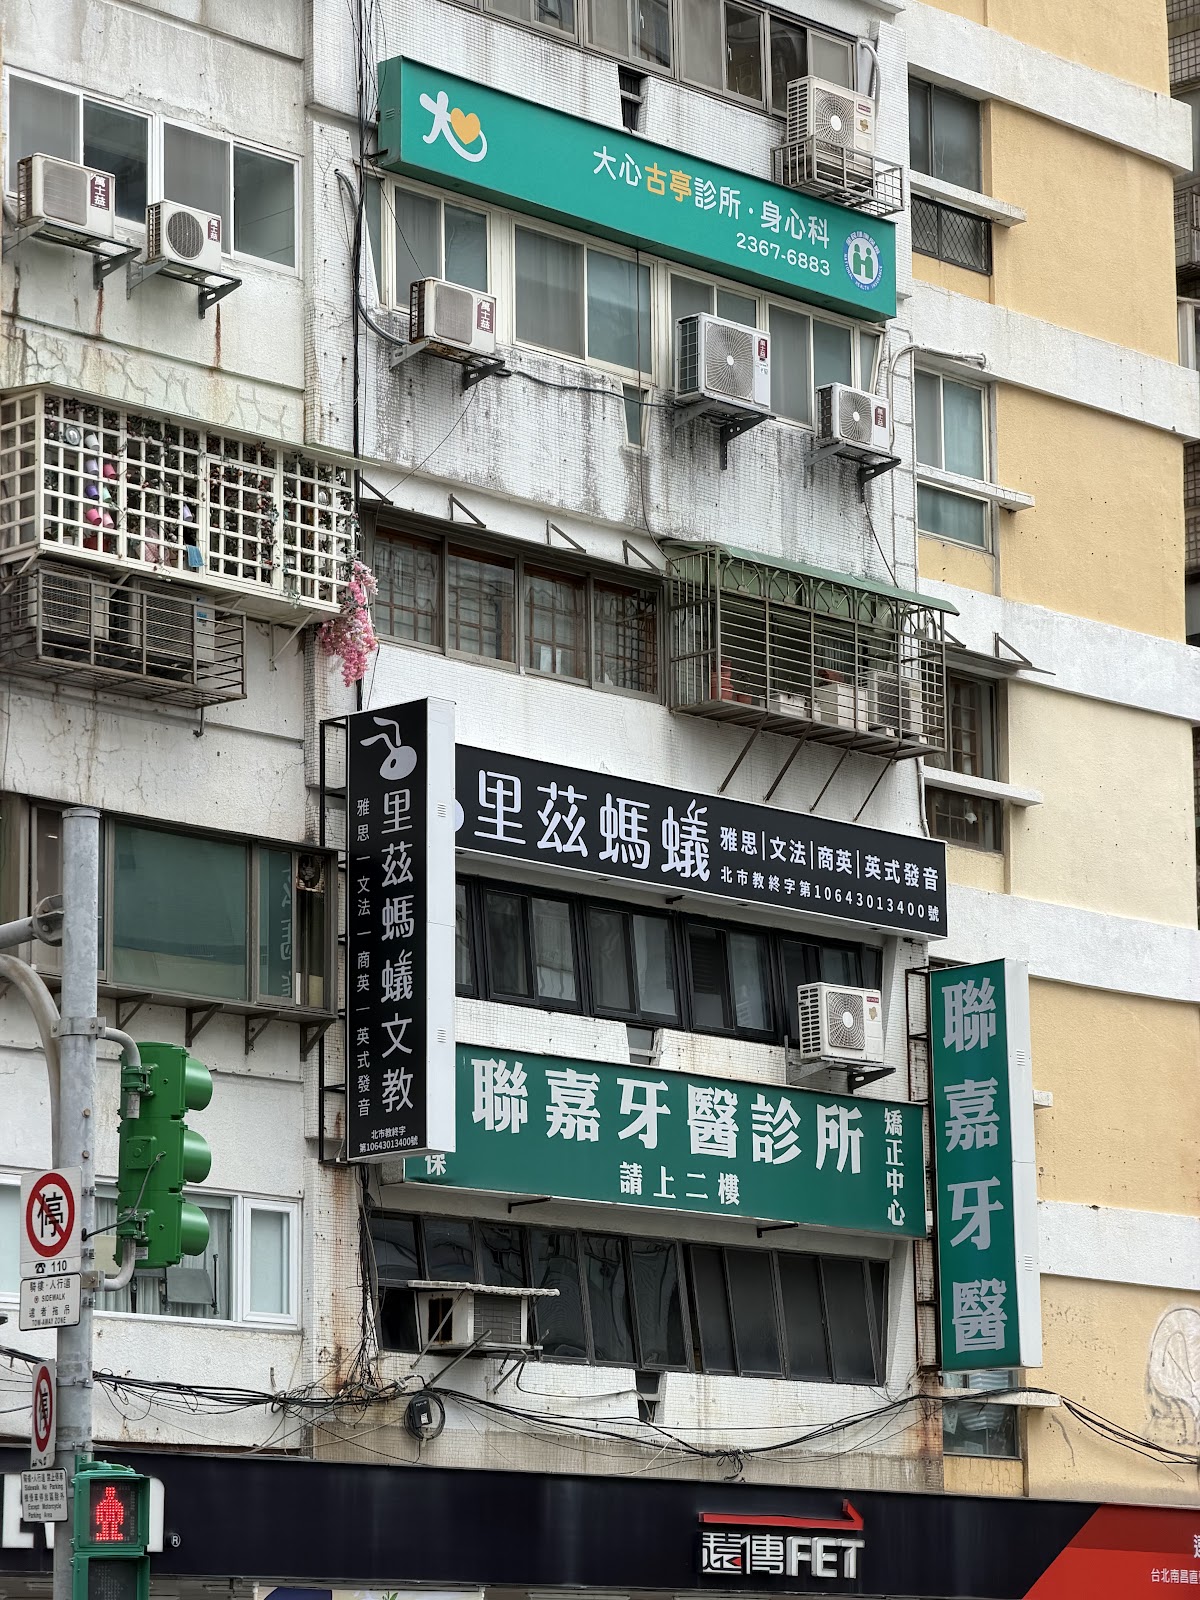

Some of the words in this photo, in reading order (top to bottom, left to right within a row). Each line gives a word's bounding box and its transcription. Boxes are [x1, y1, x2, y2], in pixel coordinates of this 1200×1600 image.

[736, 232, 831, 276] 2367-6883
[474, 769, 711, 883] 里茲螞蟻
[380, 788, 415, 1113] 里茲螞蟻文教
[470, 1057, 865, 1175] 聯嘉牙醫診所
[359, 1135, 419, 1154] 第10643013400號
[941, 977, 1005, 1355] 聯嘉牙醫
[619, 1161, 740, 1207] 請上二樓
[884, 1107, 906, 1227] 矯正中心
[37, 1191, 65, 1239] 停
[51, 1259, 67, 1273] 110
[41, 1293, 66, 1302] SIDEWALK
[54, 1316, 67, 1325] ZONE
[42, 1502, 62, 1511] Motorcycle
[49, 1483, 64, 1491] Parking
[1150, 1567, 1200, 1585] 台北南昌直
